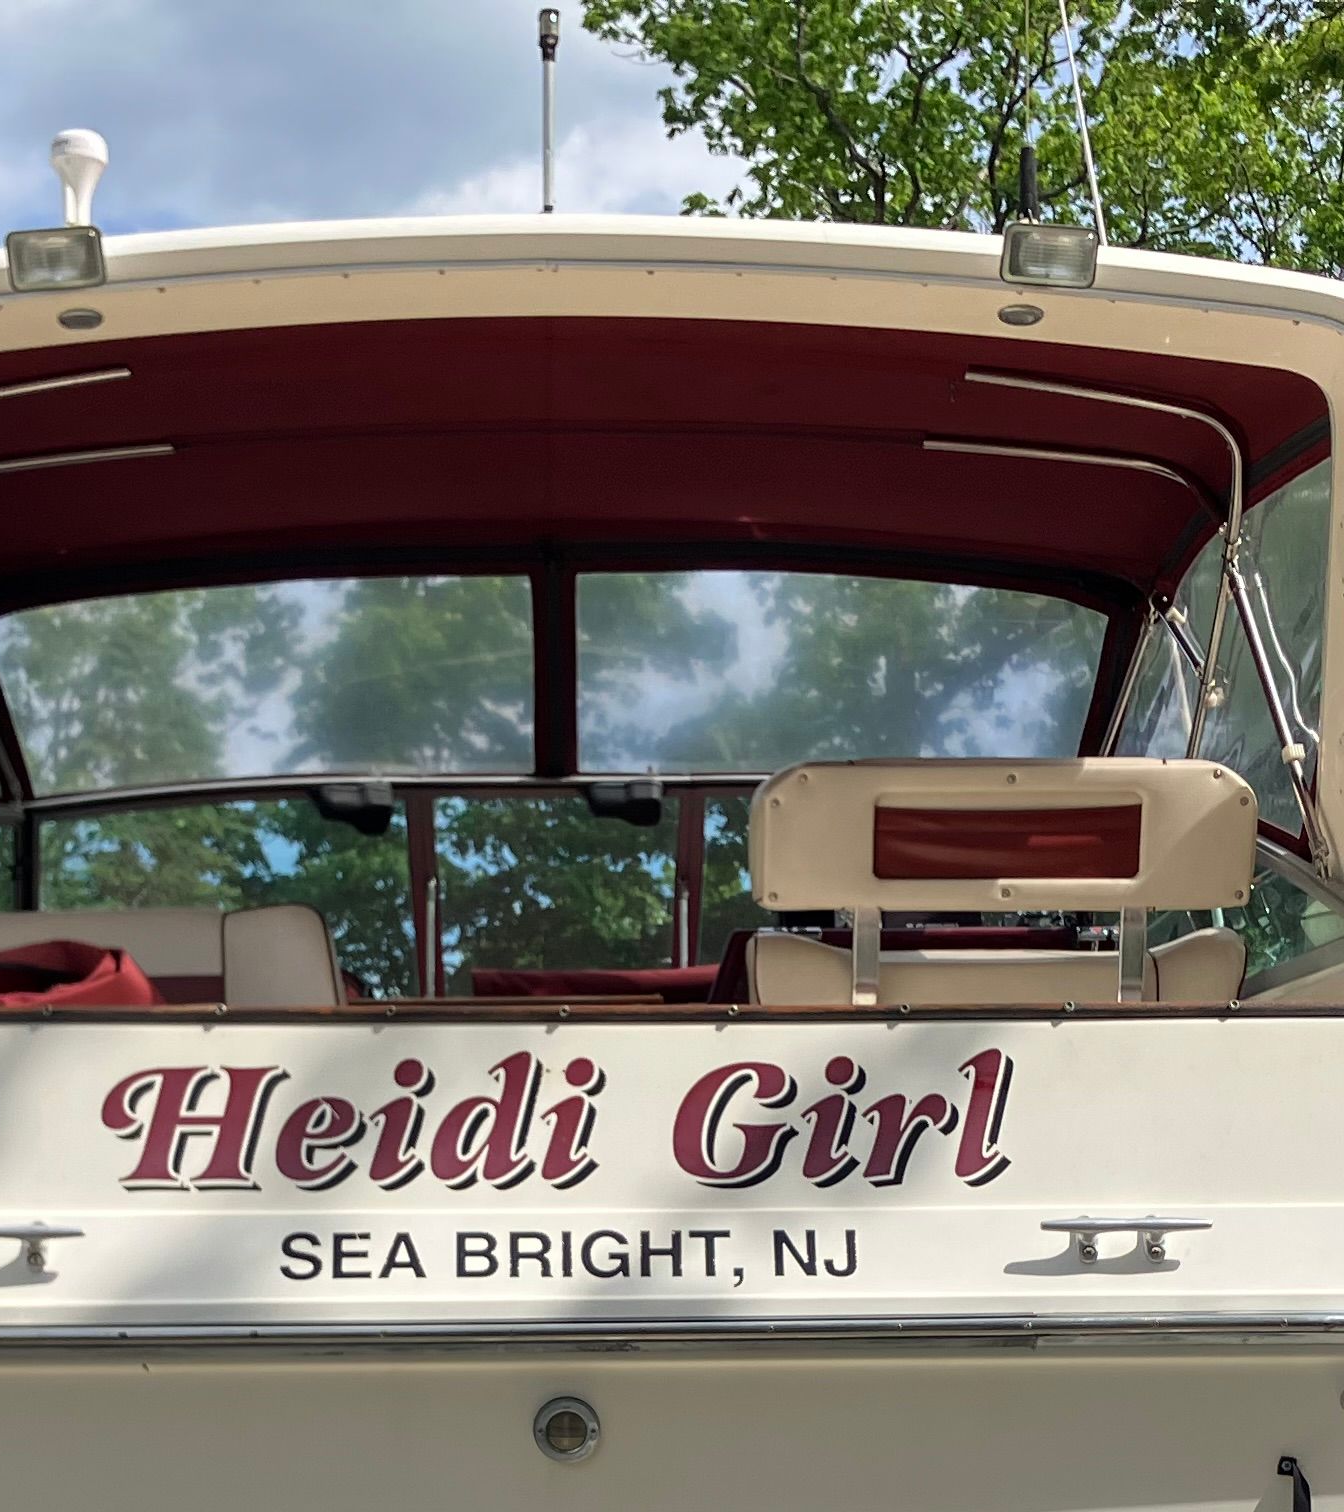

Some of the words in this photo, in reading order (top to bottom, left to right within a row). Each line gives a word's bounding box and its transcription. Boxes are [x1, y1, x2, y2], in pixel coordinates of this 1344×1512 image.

[101, 1050, 606, 1192] Heidi
[673, 1048, 1014, 1189] Girl
[280, 1232, 427, 1280] SEA
[456, 1229, 745, 1288] BRIGHT,
[773, 1229, 857, 1277] NJ
